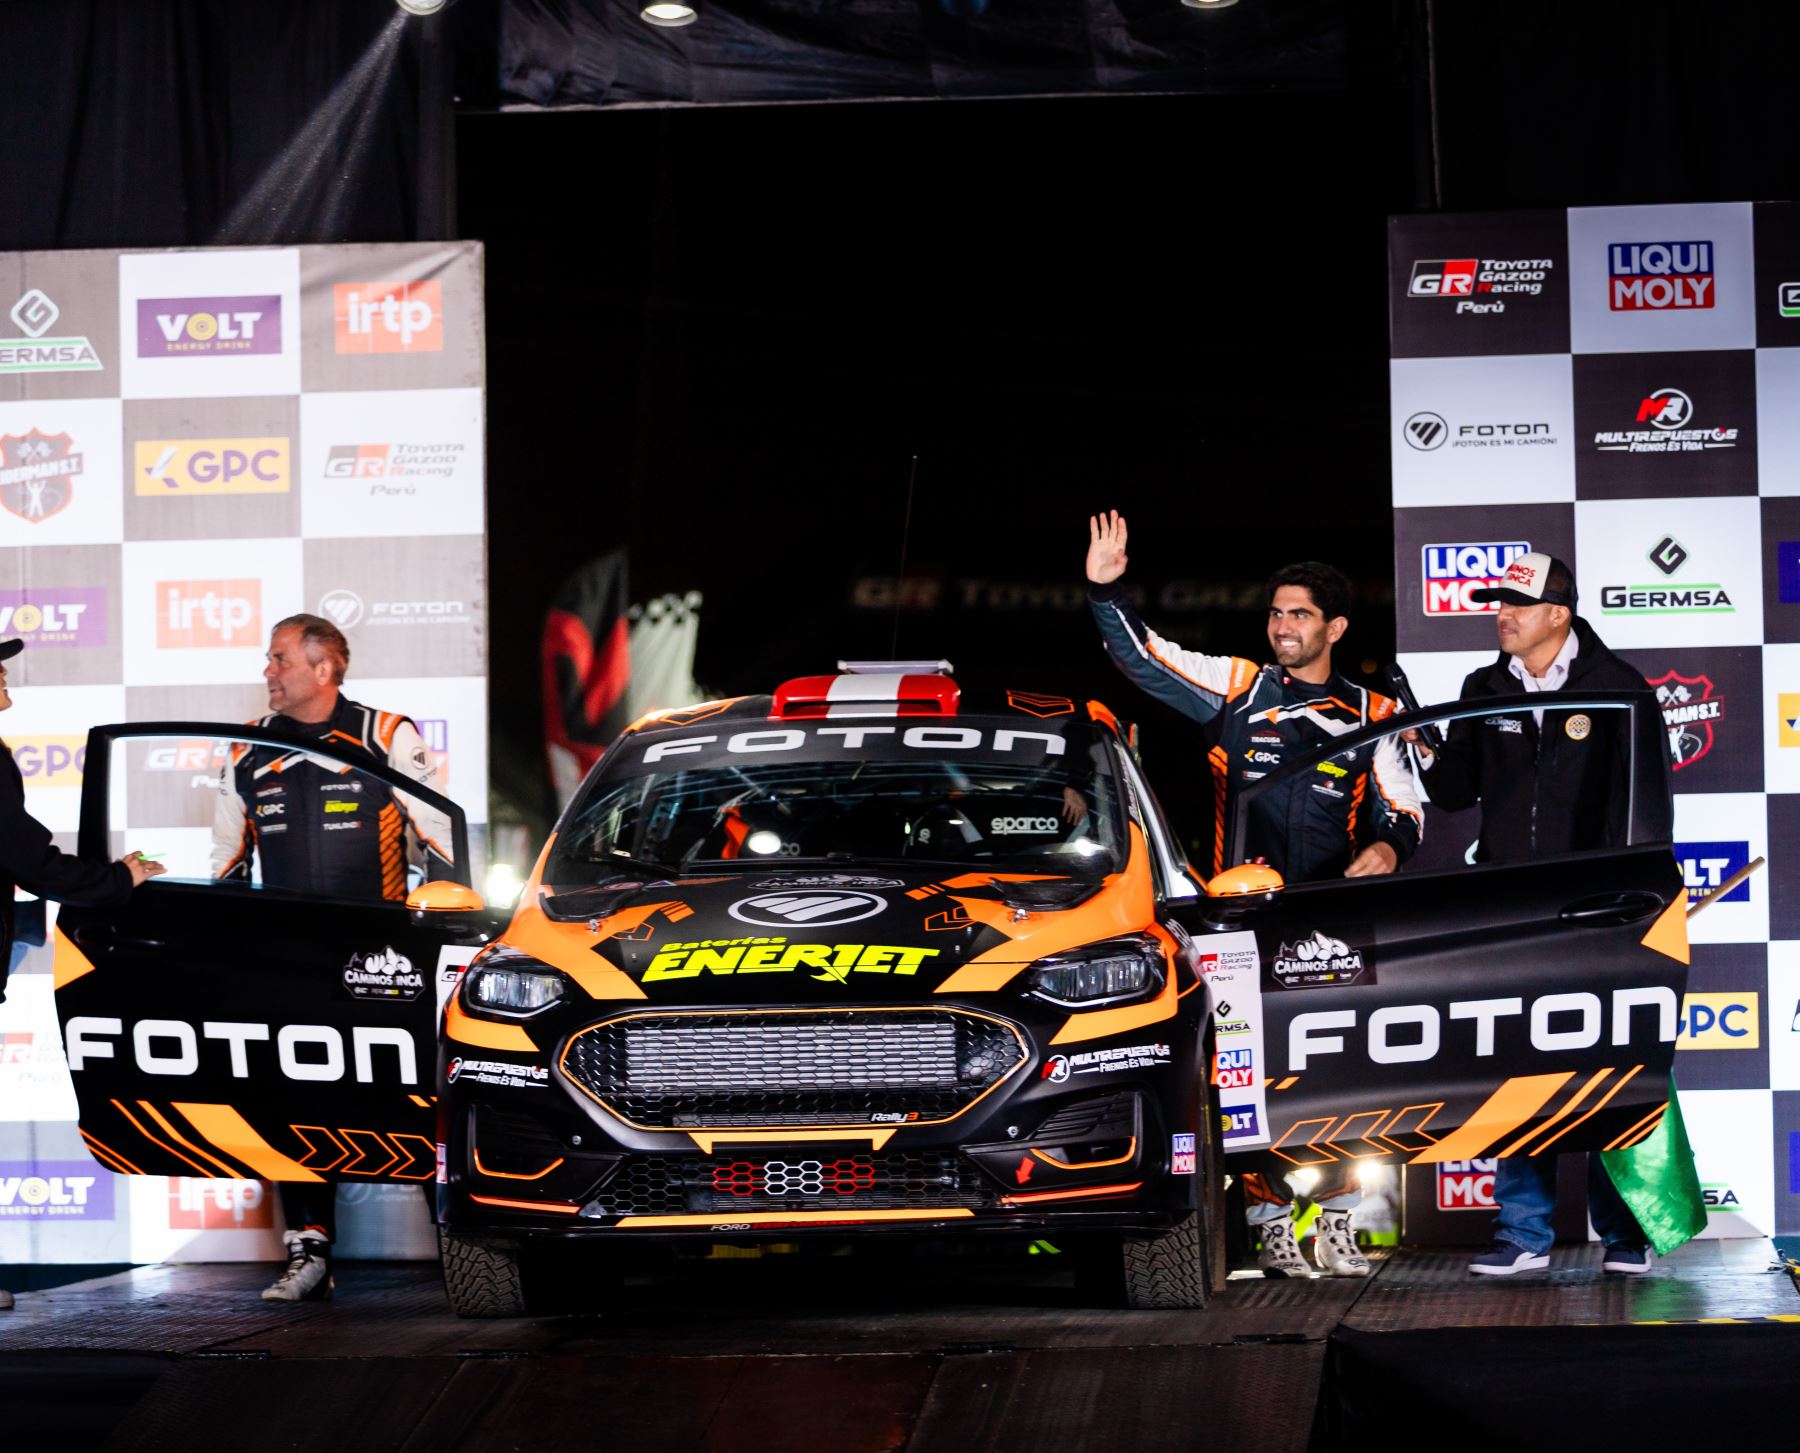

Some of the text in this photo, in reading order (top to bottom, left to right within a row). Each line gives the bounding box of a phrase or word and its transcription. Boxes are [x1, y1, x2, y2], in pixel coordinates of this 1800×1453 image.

[1481, 258, 1553, 271] TOYOTA
[1612, 243, 1709, 275] LIQUI
[1411, 273, 1473, 295] GR
[1478, 270, 1546, 283] GAZOO
[1477, 281, 1543, 296] Racing
[1613, 277, 1714, 309] MOLY
[155, 312, 263, 342] VOLT
[347, 292, 432, 343] irtp
[1635, 396, 1685, 422] MR
[1459, 422, 1550, 437] FOTON
[395, 443, 465, 454] TOYOTA
[187, 448, 281, 483] GPC
[326, 457, 385, 478] GR
[372, 601, 464, 616] FOTON
[1600, 585, 1733, 610] GERMSA
[169, 589, 253, 640] irtp
[642, 726, 1067, 764] FOTON
[1254, 751, 1281, 765] GPC
[991, 816, 1059, 836] sparco
[1288, 986, 1677, 1071] FOTON
[64, 1016, 419, 1085] FOTON
[871, 1111, 920, 1123] Rally3
[710, 1223, 752, 1232] FORD
